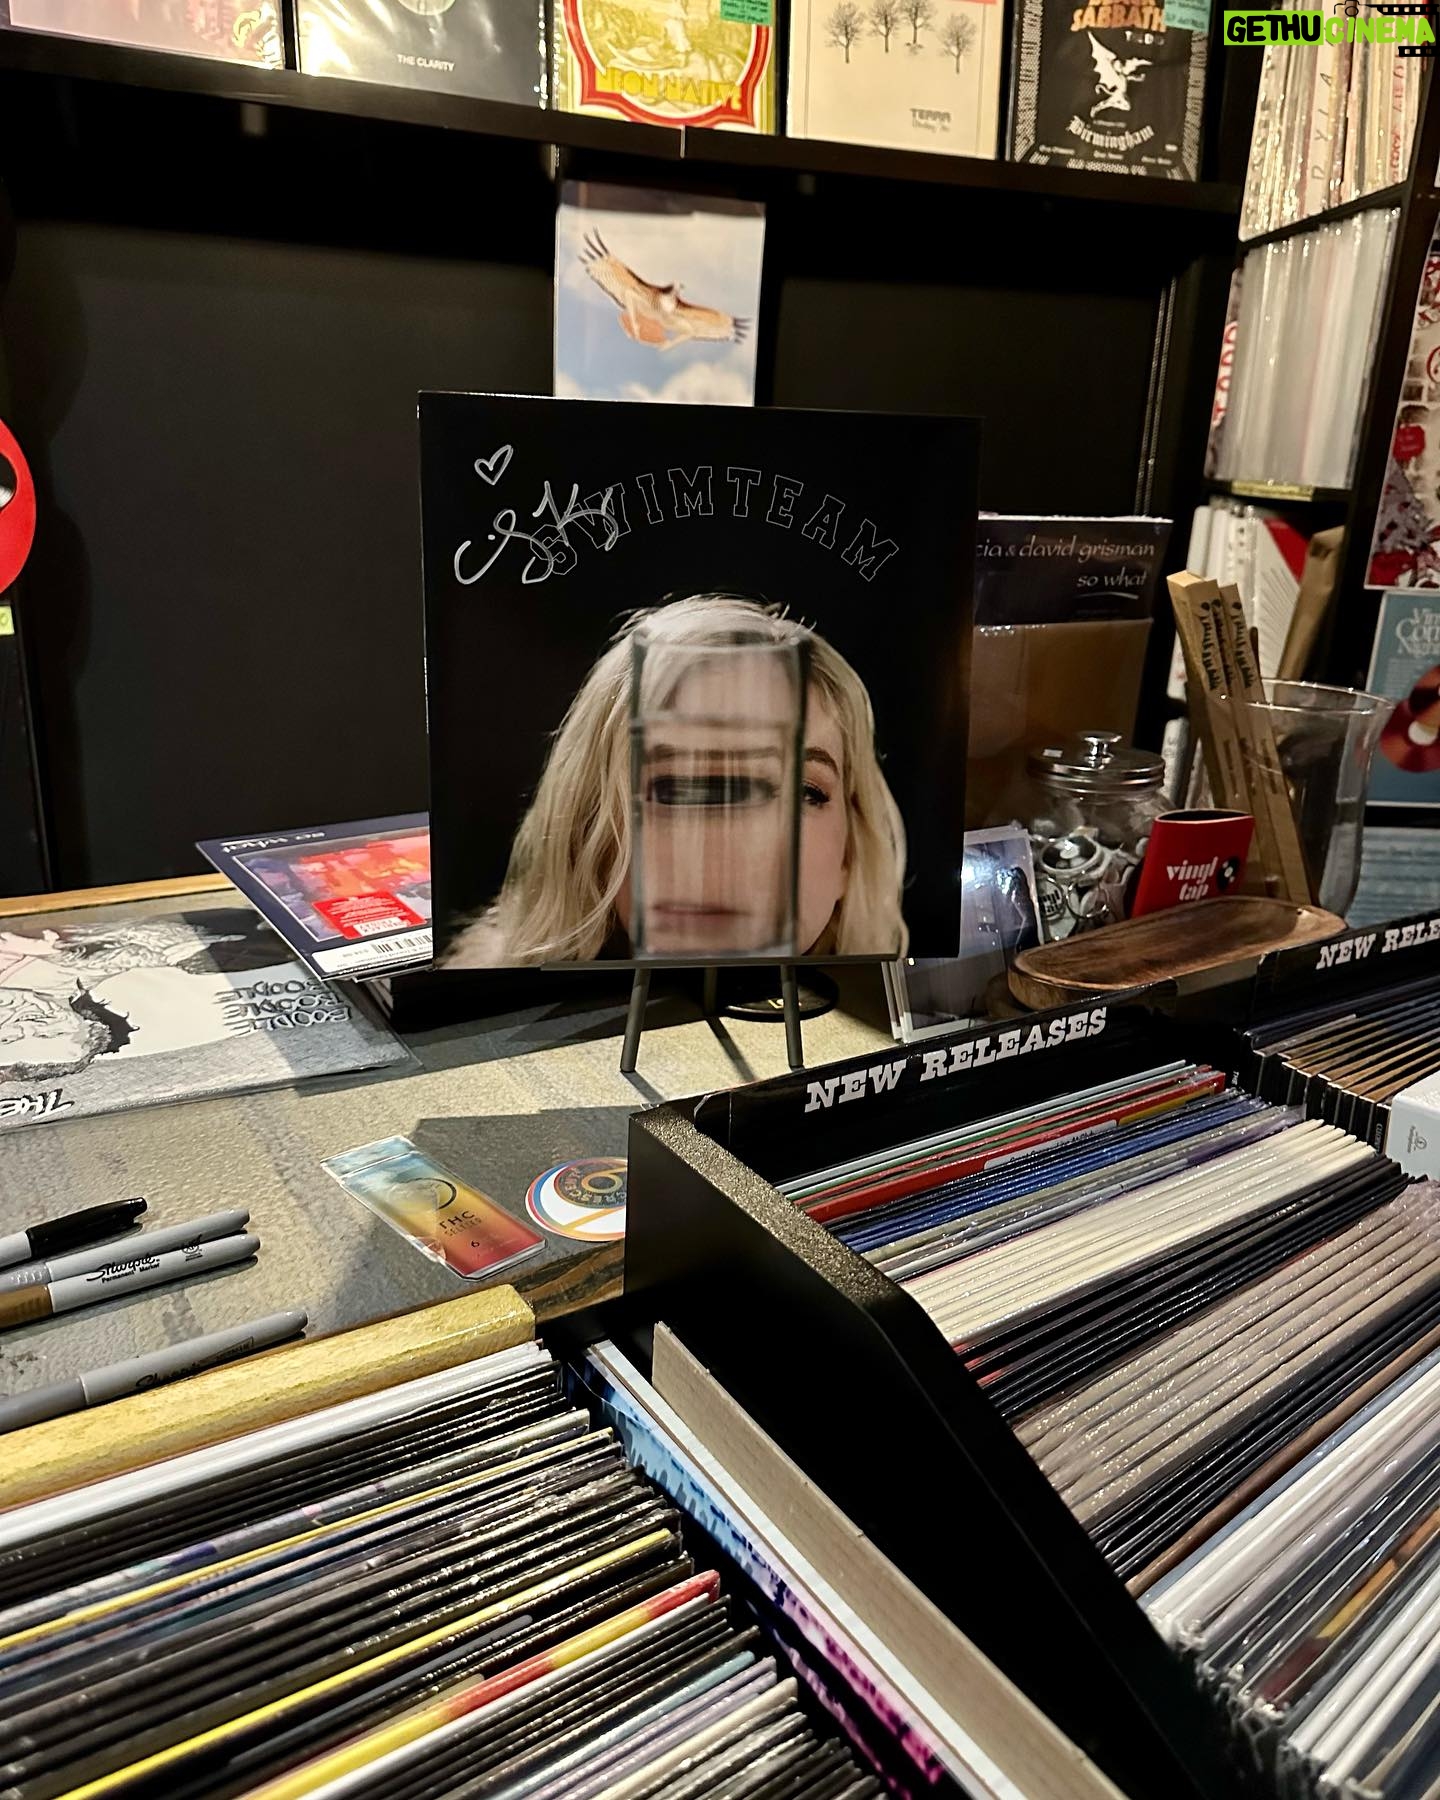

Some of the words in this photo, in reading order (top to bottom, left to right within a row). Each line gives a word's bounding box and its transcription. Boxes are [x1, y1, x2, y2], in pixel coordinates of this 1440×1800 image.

[1071, 4, 1167, 32] SABBATH
[397, 54, 415, 65] THE
[416, 57, 455, 71] CLARITY
[1066, 115, 1154, 150] Birmingham
[1019, 535, 1076, 557] david
[1078, 539, 1154, 563] grisman
[1077, 574, 1098, 587] so
[1104, 566, 1147, 588] what
[1166, 856, 1218, 883] vinyl
[1179, 882, 1209, 901] tap
[1316, 934, 1376, 970] NEW
[1382, 919, 1440, 953] RELE
[805, 1059, 907, 1112] NEW
[920, 1007, 1107, 1082] RELEASES
[440, 1211, 475, 1229] THC
[86, 1253, 157, 1281] Sharpie
[102, 1270, 135, 1283] Permanent
[139, 1263, 160, 1272] Marker
